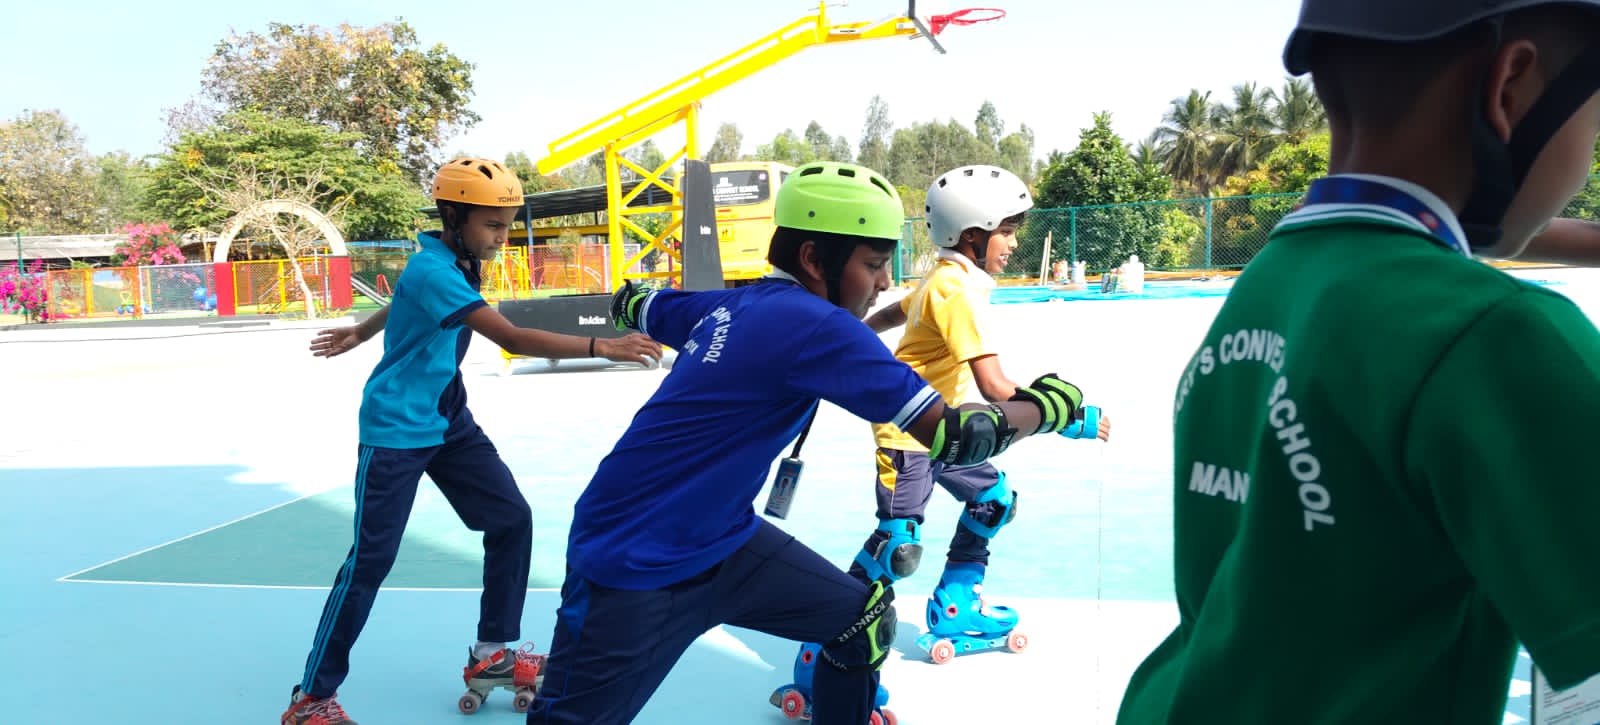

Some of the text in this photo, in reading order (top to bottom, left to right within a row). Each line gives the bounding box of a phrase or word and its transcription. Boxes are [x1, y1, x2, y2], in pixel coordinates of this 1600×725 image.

[1188, 461, 1250, 504] MAN
[1219, 328, 1286, 374] CONVE
[1267, 375, 1336, 532] SCHOOL
